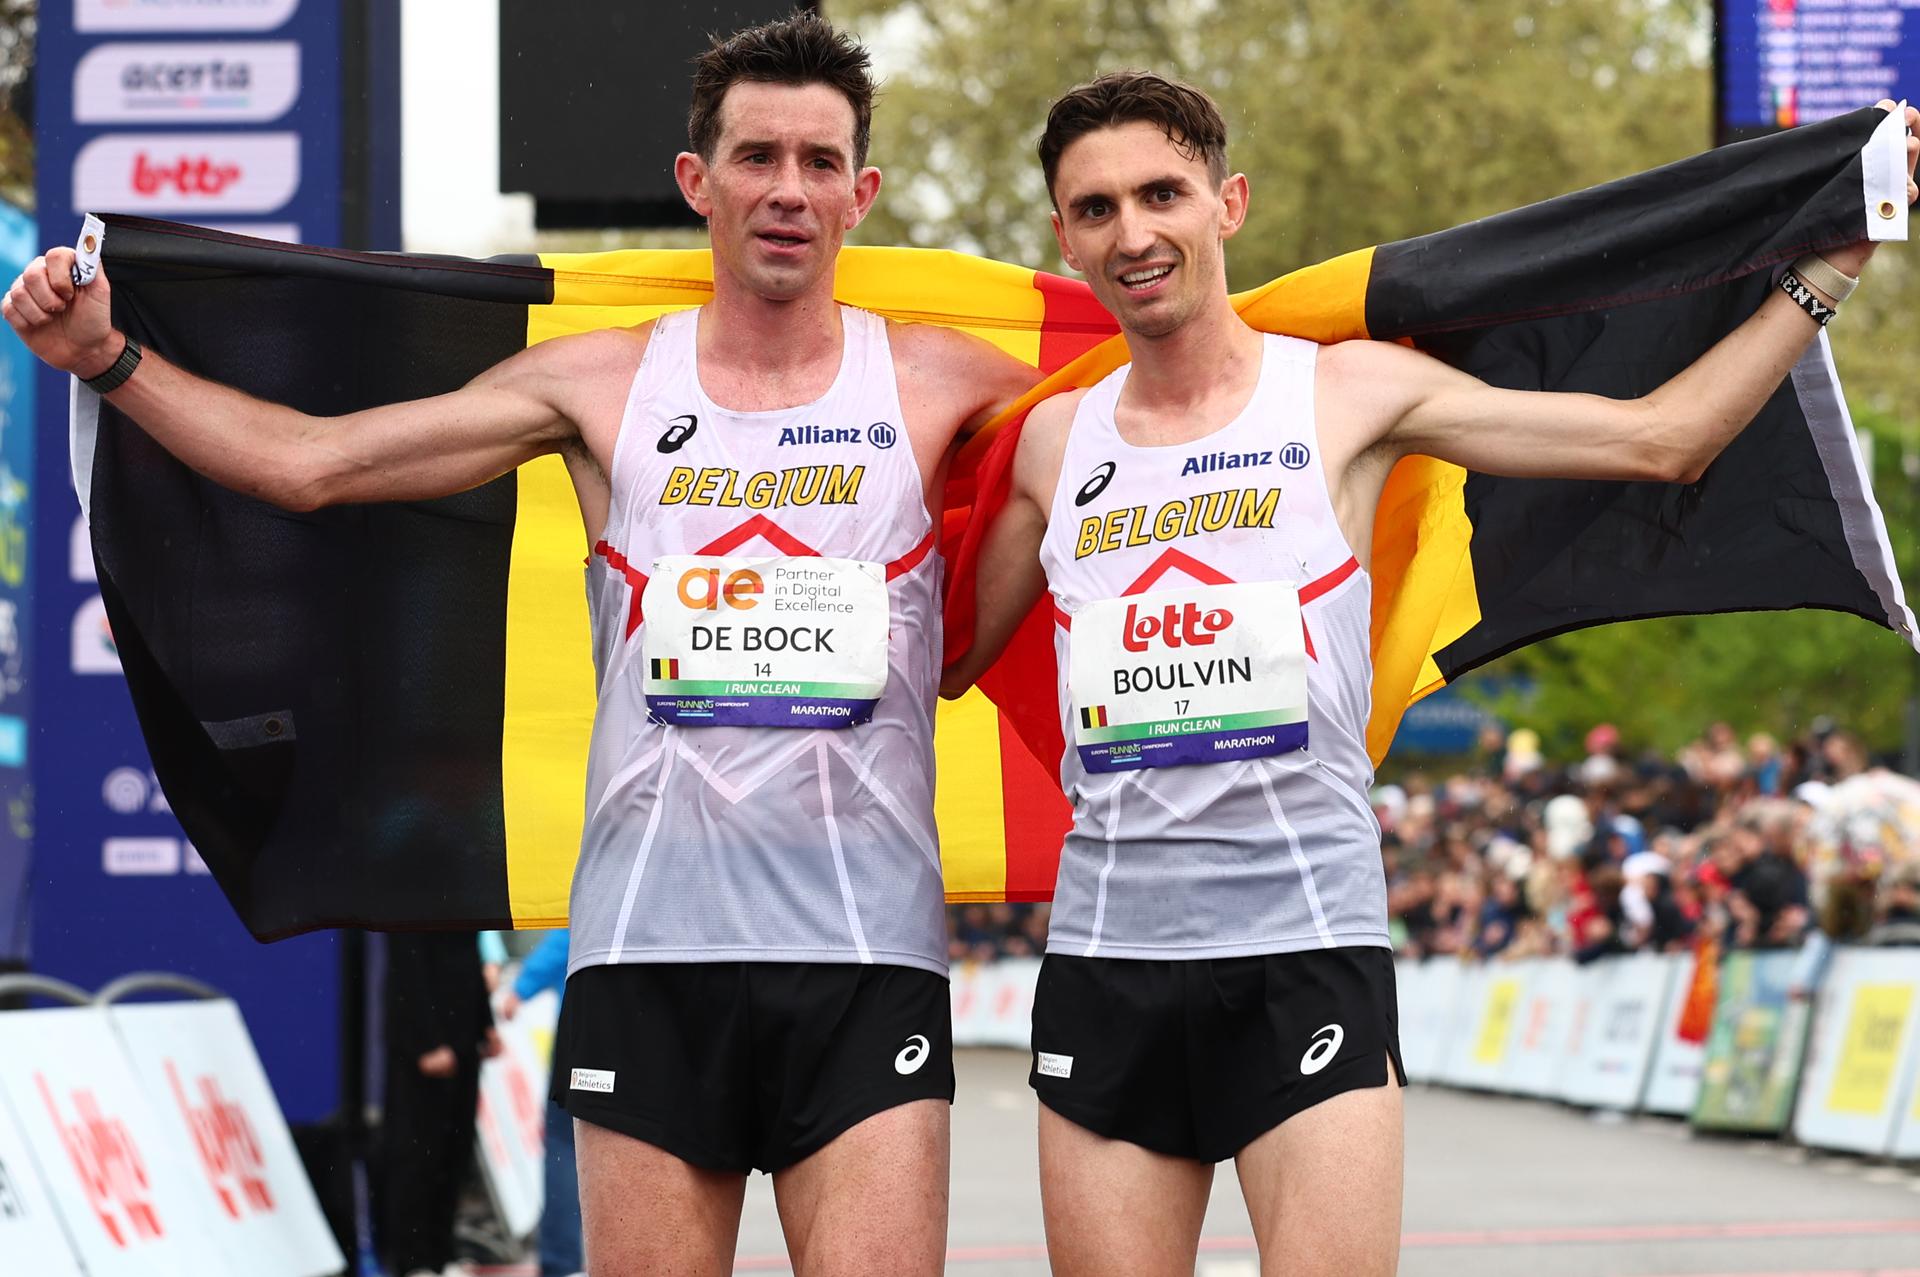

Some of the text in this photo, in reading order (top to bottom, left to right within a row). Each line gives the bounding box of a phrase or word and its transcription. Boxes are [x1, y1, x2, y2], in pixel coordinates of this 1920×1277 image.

[121, 60, 251, 91] acerta
[777, 425, 862, 446] Allianz
[1181, 450, 1273, 477] Allianz
[658, 464, 866, 510] BELGIUM
[1075, 488, 1282, 561] BELGIUM
[776, 568, 834, 582] Partner
[677, 567, 764, 610] ae
[775, 584, 841, 600] in Digital
[775, 598, 854, 614] Excellence
[692, 626, 835, 653] DE BOCK
[754, 663, 772, 677] 14
[1114, 657, 1252, 695] BOULVIN
[731, 684, 758, 694] RUN
[759, 684, 801, 695] CLEAN
[677, 700, 714, 709] RUNNING
[791, 705, 851, 717] MARATHON
[1174, 700, 1190, 715] 17
[1155, 722, 1181, 734] RUN
[1183, 718, 1222, 731] CLEAN
[1214, 735, 1275, 750] MARATHON
[1043, 1064, 1069, 1076] Athletics
[577, 1079, 611, 1090] Athletics
